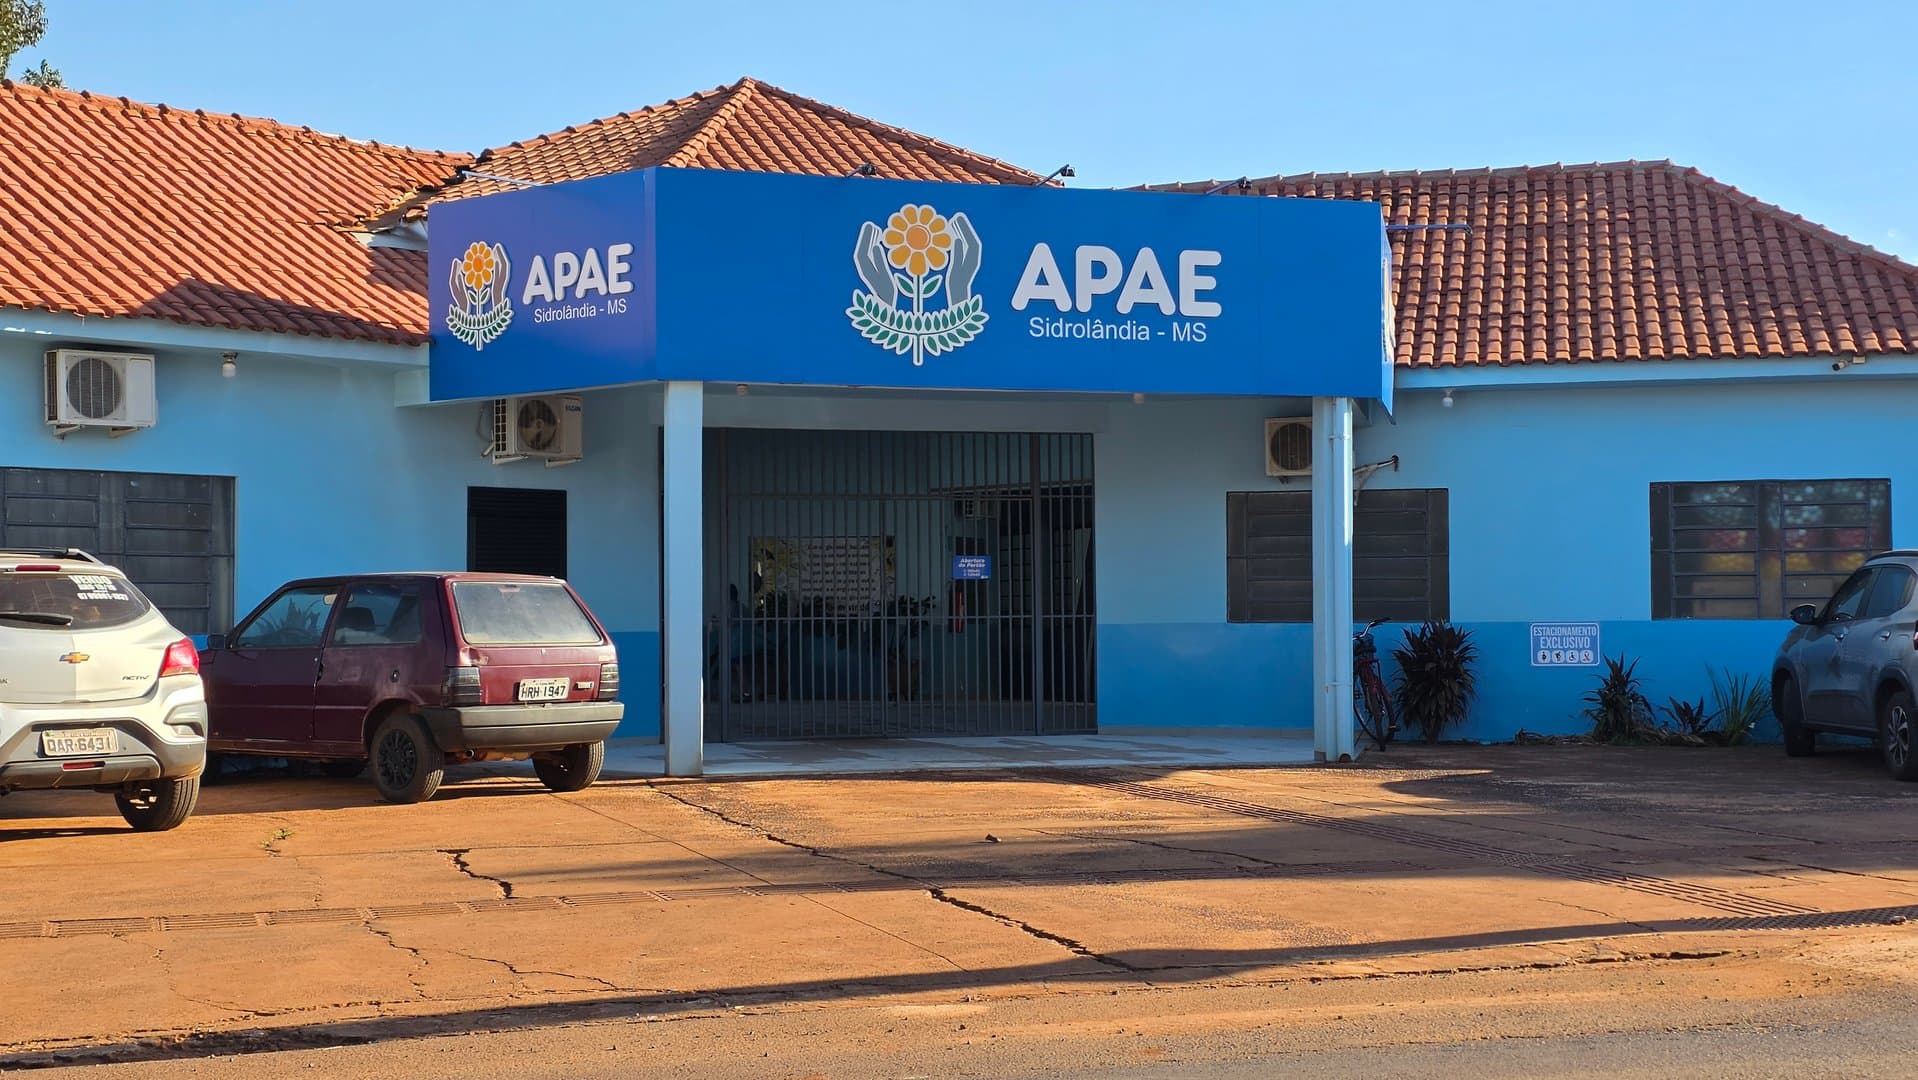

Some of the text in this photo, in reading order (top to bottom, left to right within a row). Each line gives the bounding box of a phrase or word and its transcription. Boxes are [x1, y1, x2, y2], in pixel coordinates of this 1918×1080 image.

[522, 243, 634, 305] APAE
[1011, 242, 1222, 318] APAE
[534, 303, 596, 323] Sidrolândia
[607, 298, 627, 315] MS
[1028, 316, 1150, 341] Sidrolândia
[1172, 321, 1208, 342] MS
[1533, 626, 1597, 636] ESTACIONAMENTO
[1540, 636, 1590, 649] EXCLUSIVO
